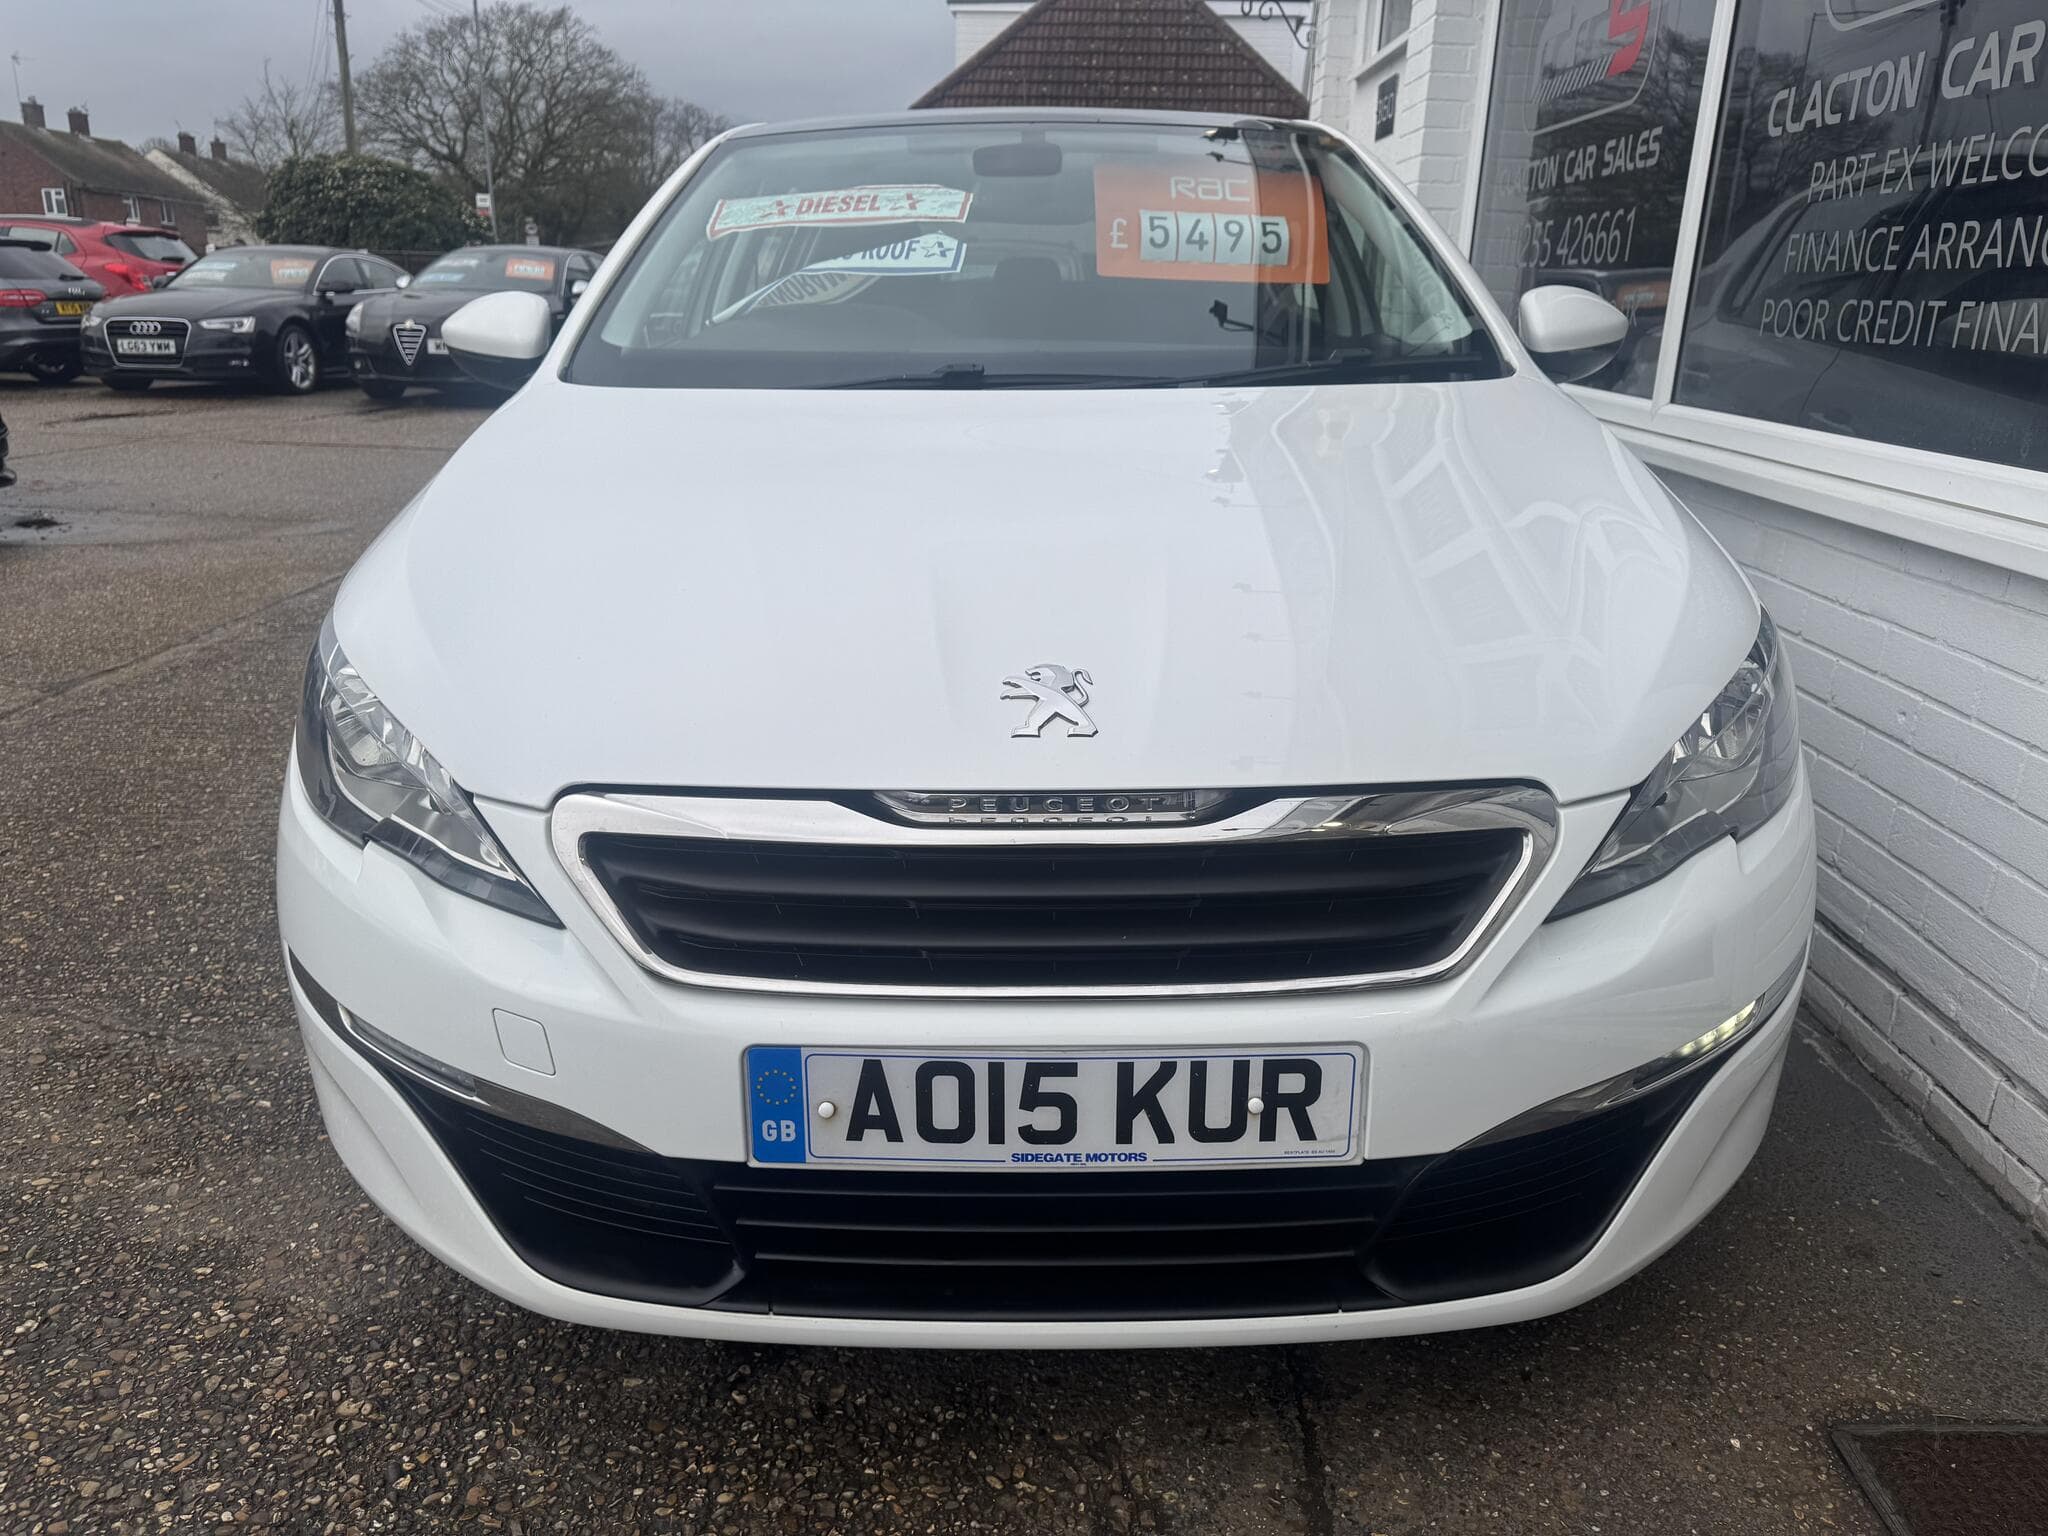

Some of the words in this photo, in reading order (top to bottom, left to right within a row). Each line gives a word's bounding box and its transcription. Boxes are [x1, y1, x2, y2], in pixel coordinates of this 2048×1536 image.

[1767, 51, 1926, 138] CLACTON
[1940, 20, 2047, 100] CAR
[1564, 144, 1598, 184] CAR
[1601, 126, 1664, 177] SALES
[1808, 152, 1877, 203] PART
[1879, 144, 1922, 195] EX
[795, 193, 880, 216] DIESEL
[1148, 215, 1283, 255] 5495
[1556, 206, 1638, 267] 426661
[1784, 225, 1905, 273] FINANCE
[1907, 214, 2048, 271] ARRAN
[1759, 299, 1830, 341] POOR
[1836, 299, 1948, 348] CREDIT
[1951, 300, 2048, 355] FINA
[949, 797, 1154, 812] PEUGEOT
[846, 1058, 1079, 1146] AO15
[1115, 1058, 1323, 1146] KUR
[761, 1119, 797, 1143] GB
[1011, 1152, 1083, 1163] SIDEGATE
[1085, 1152, 1148, 1163] MOTORS
